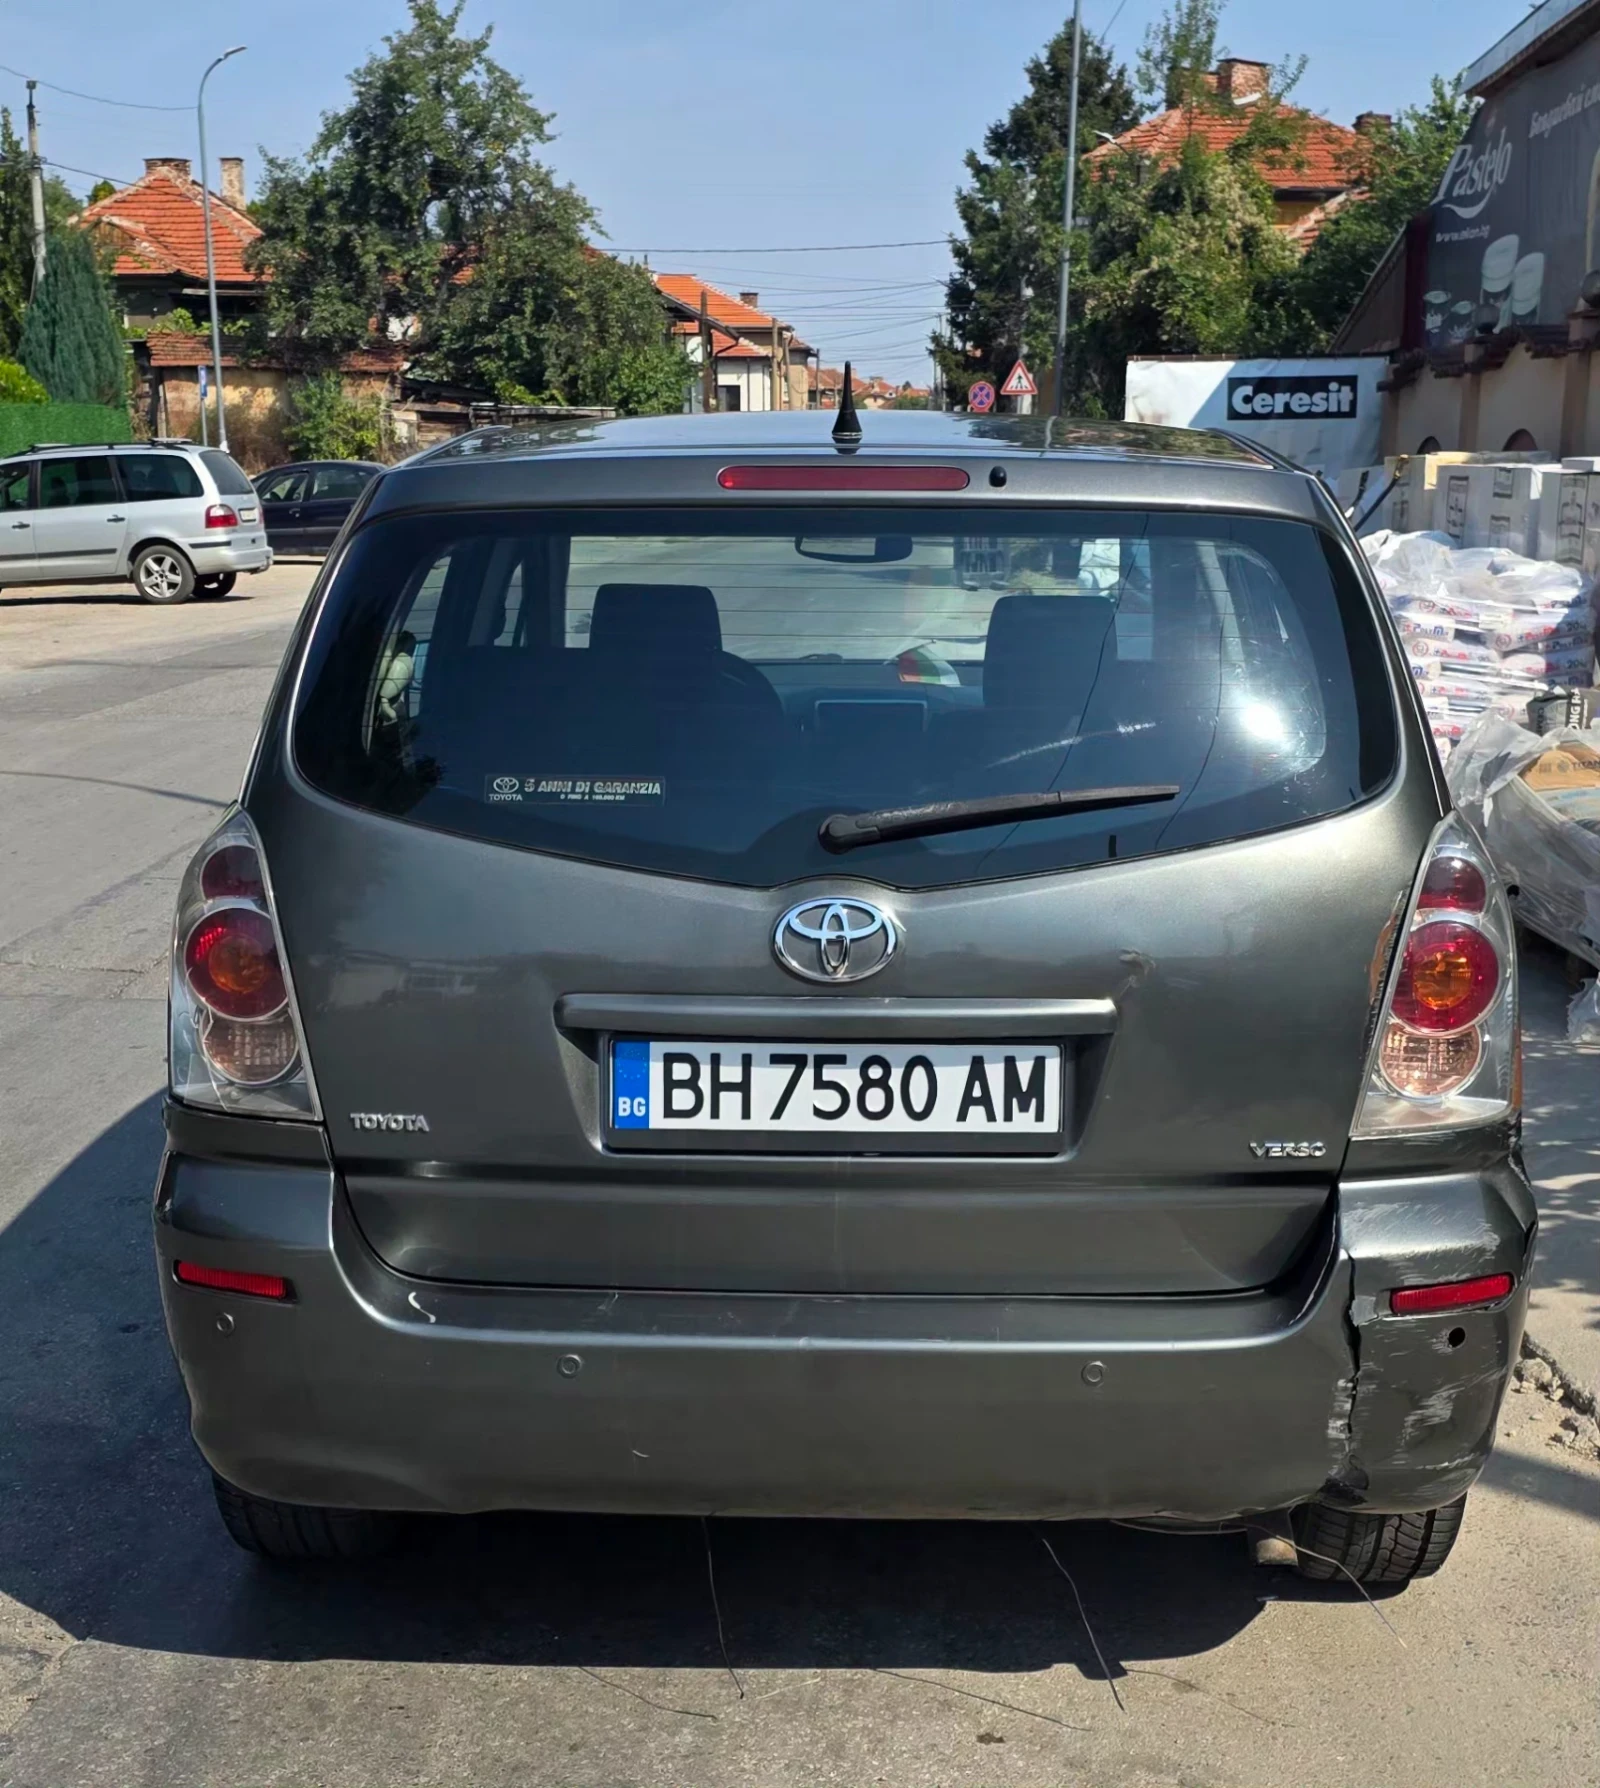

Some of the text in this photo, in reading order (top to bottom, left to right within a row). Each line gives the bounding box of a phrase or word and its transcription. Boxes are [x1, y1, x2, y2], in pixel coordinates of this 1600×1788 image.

[1429, 126, 1513, 206] Pastelo
[1232, 381, 1354, 414] Ceresit
[524, 779, 661, 795] 5 ANNI DI GARANZIA
[663, 1052, 1046, 1122] BH 7580 AM
[618, 1097, 646, 1117] BG
[350, 1113, 430, 1132] TOYOTA
[1249, 1141, 1327, 1157] VERSO
